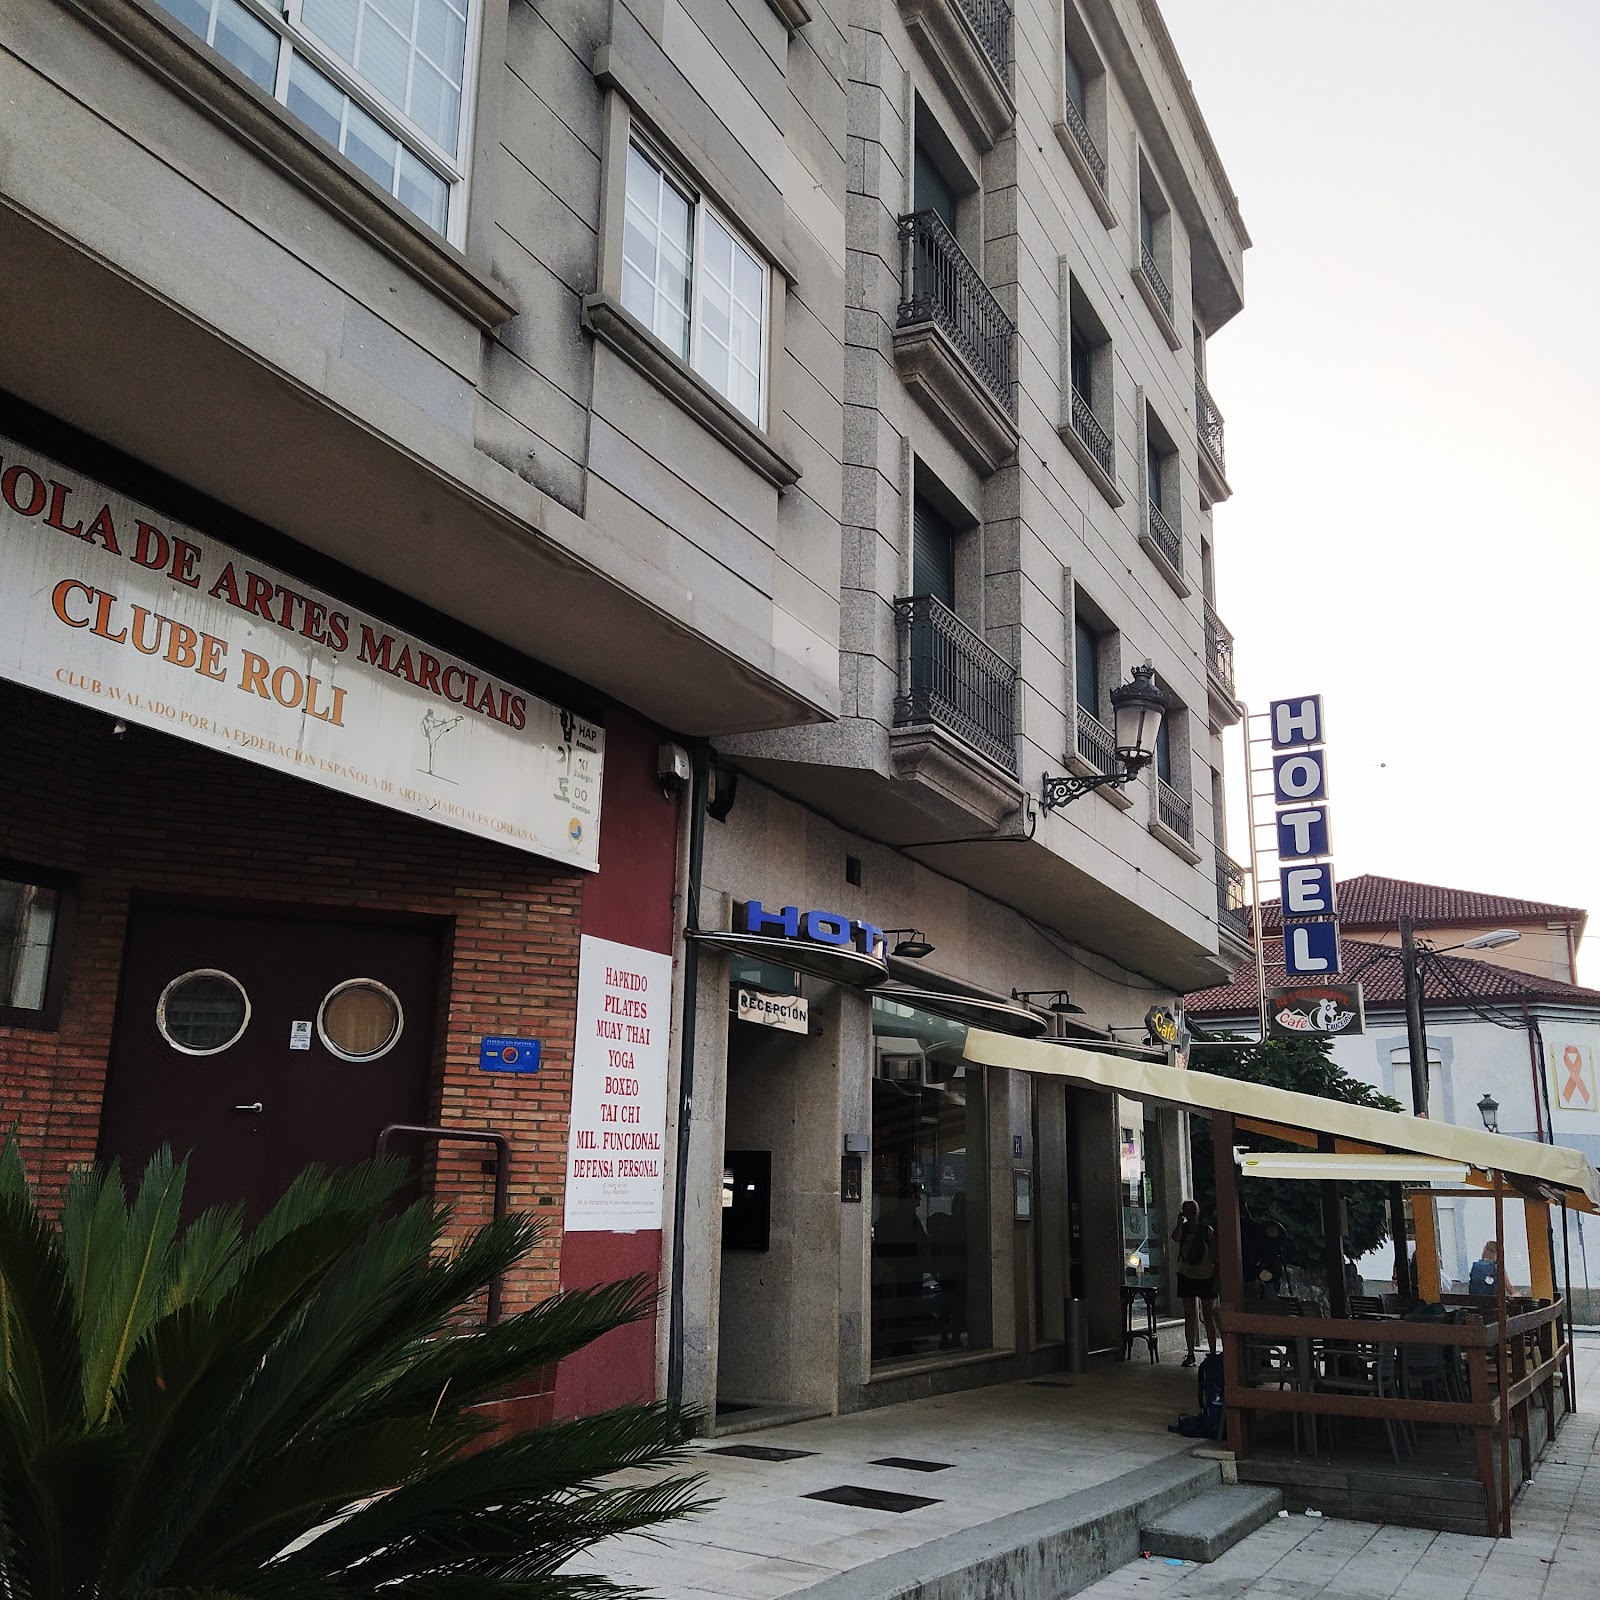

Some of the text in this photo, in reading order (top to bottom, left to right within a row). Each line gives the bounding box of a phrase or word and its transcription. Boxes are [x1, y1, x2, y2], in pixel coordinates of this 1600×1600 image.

[0, 455, 526, 731] OLA DE ARTES MARCIAIS
[52, 578, 347, 727] CLUBE ROLI
[578, 724, 597, 741] HAP
[55, 668, 101, 694] CLUB
[104, 686, 176, 719] AVALADO
[180, 710, 208, 731] POR
[212, 721, 230, 738] LA
[319, 758, 379, 788] ESPAÑOLA
[380, 780, 394, 793] DE
[398, 787, 429, 806] ARTES
[430, 799, 489, 824] MARCIALES
[490, 818, 539, 842] COREANAS
[574, 787, 588, 801] DO
[1276, 699, 1328, 971] HOTEL
[744, 900, 888, 968] HOT
[605, 966, 648, 992] HAPKIDO
[604, 994, 648, 1019] PILATES
[596, 1019, 651, 1046] MUAY THAI
[608, 1049, 635, 1069] YOGA
[604, 1076, 639, 1096] BOXEO
[600, 1103, 641, 1124] TAI CHI
[576, 1130, 661, 1151] MIL. FUNCIONAL
[573, 1159, 659, 1178] DEFENSA PERSONAL
